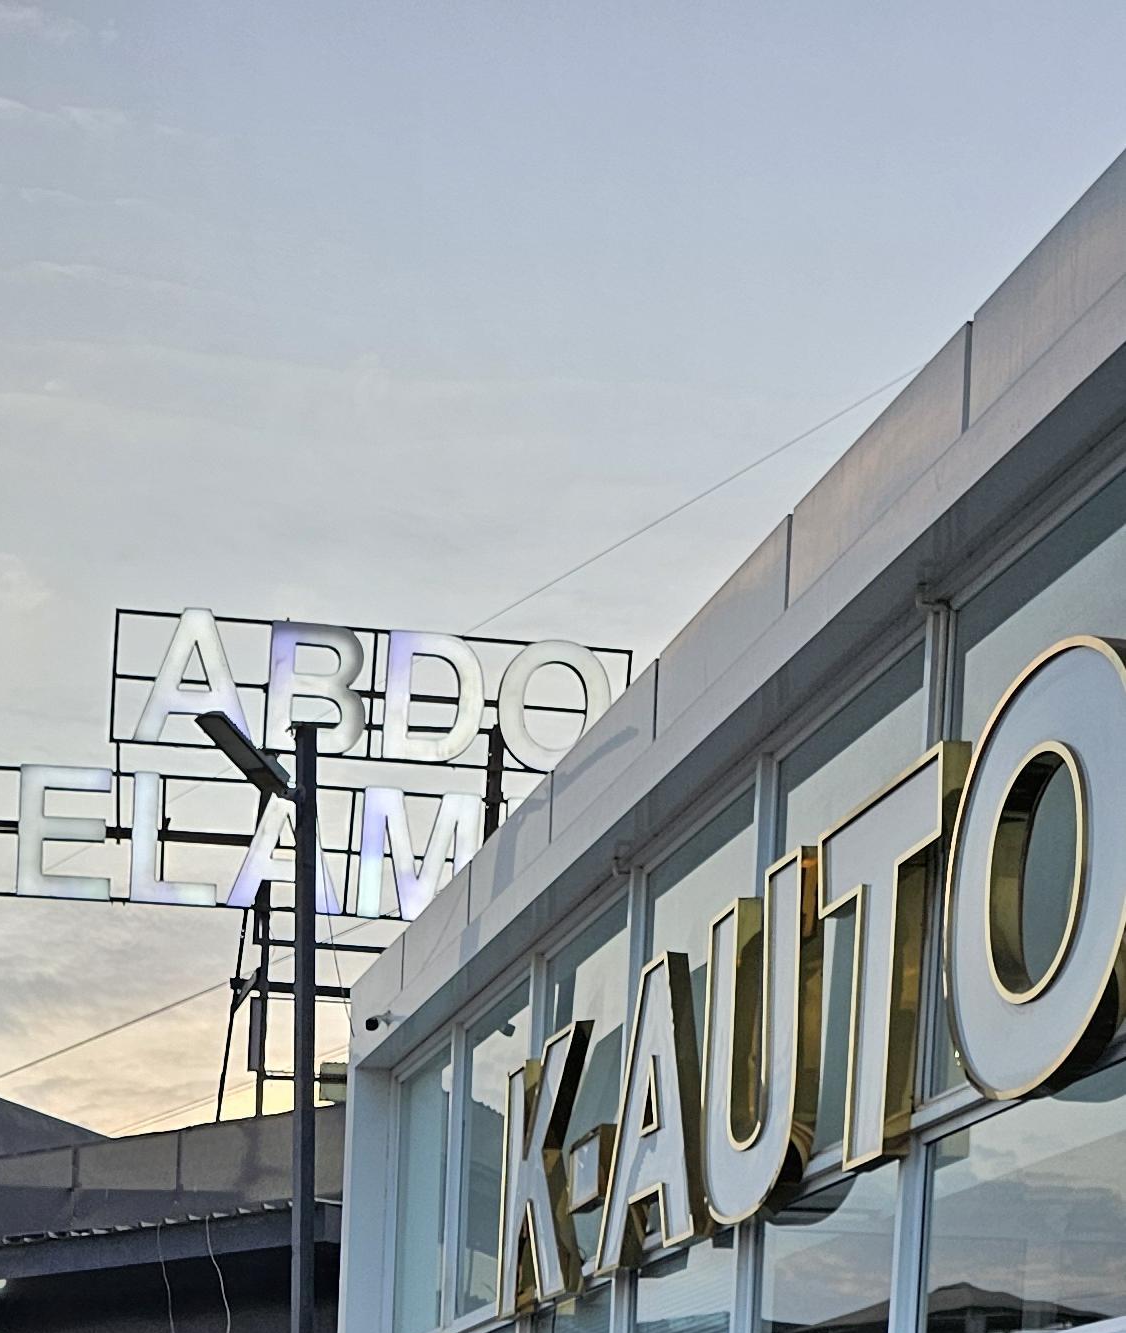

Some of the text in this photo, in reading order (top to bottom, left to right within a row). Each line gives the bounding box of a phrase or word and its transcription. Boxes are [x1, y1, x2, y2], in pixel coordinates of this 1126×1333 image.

[135, 606, 612, 773] ABDO
[16, 763, 508, 922] ELAM
[496, 635, 1126, 1319] K-AUTO
